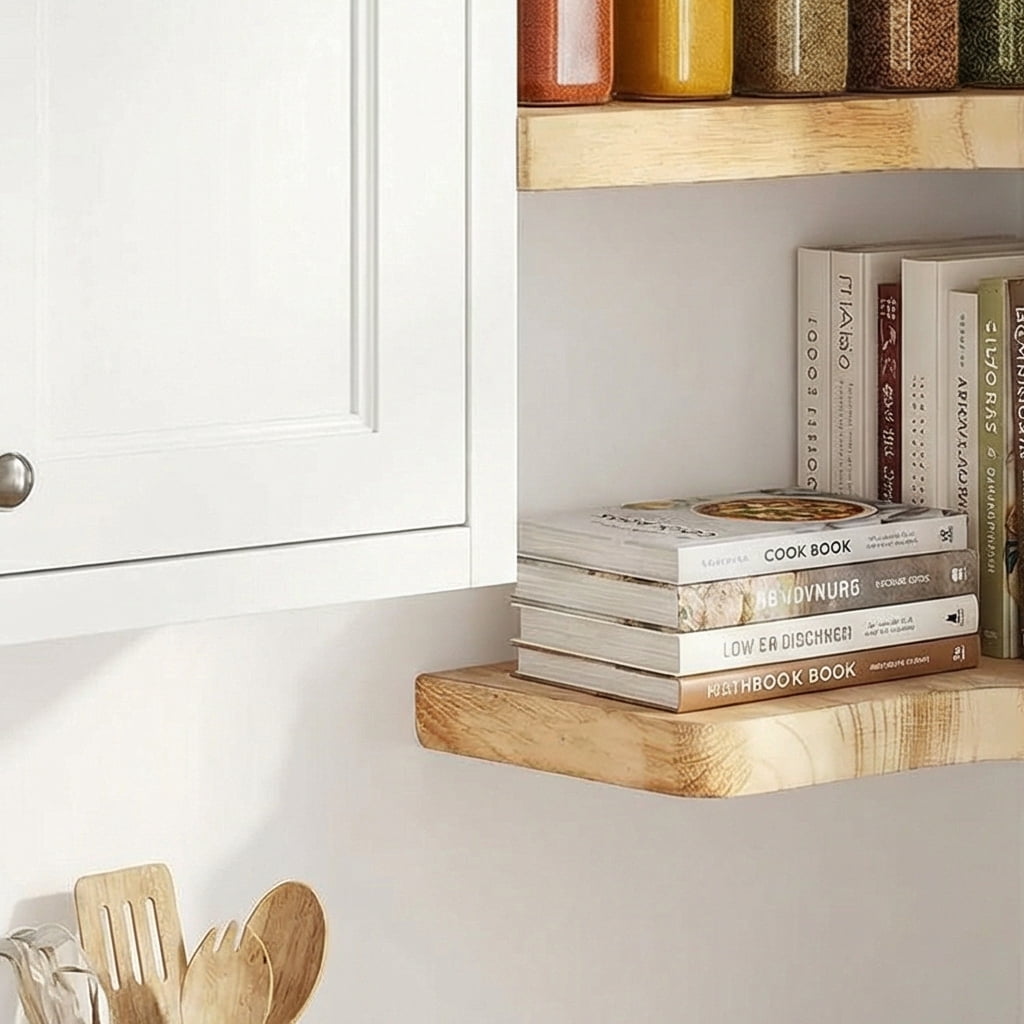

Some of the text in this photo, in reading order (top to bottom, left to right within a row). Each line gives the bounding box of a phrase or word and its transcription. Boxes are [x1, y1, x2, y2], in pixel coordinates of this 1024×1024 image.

[764, 544, 807, 562] COOK
[811, 539, 852, 557] BOOK
[809, 660, 857, 684] BOOK
